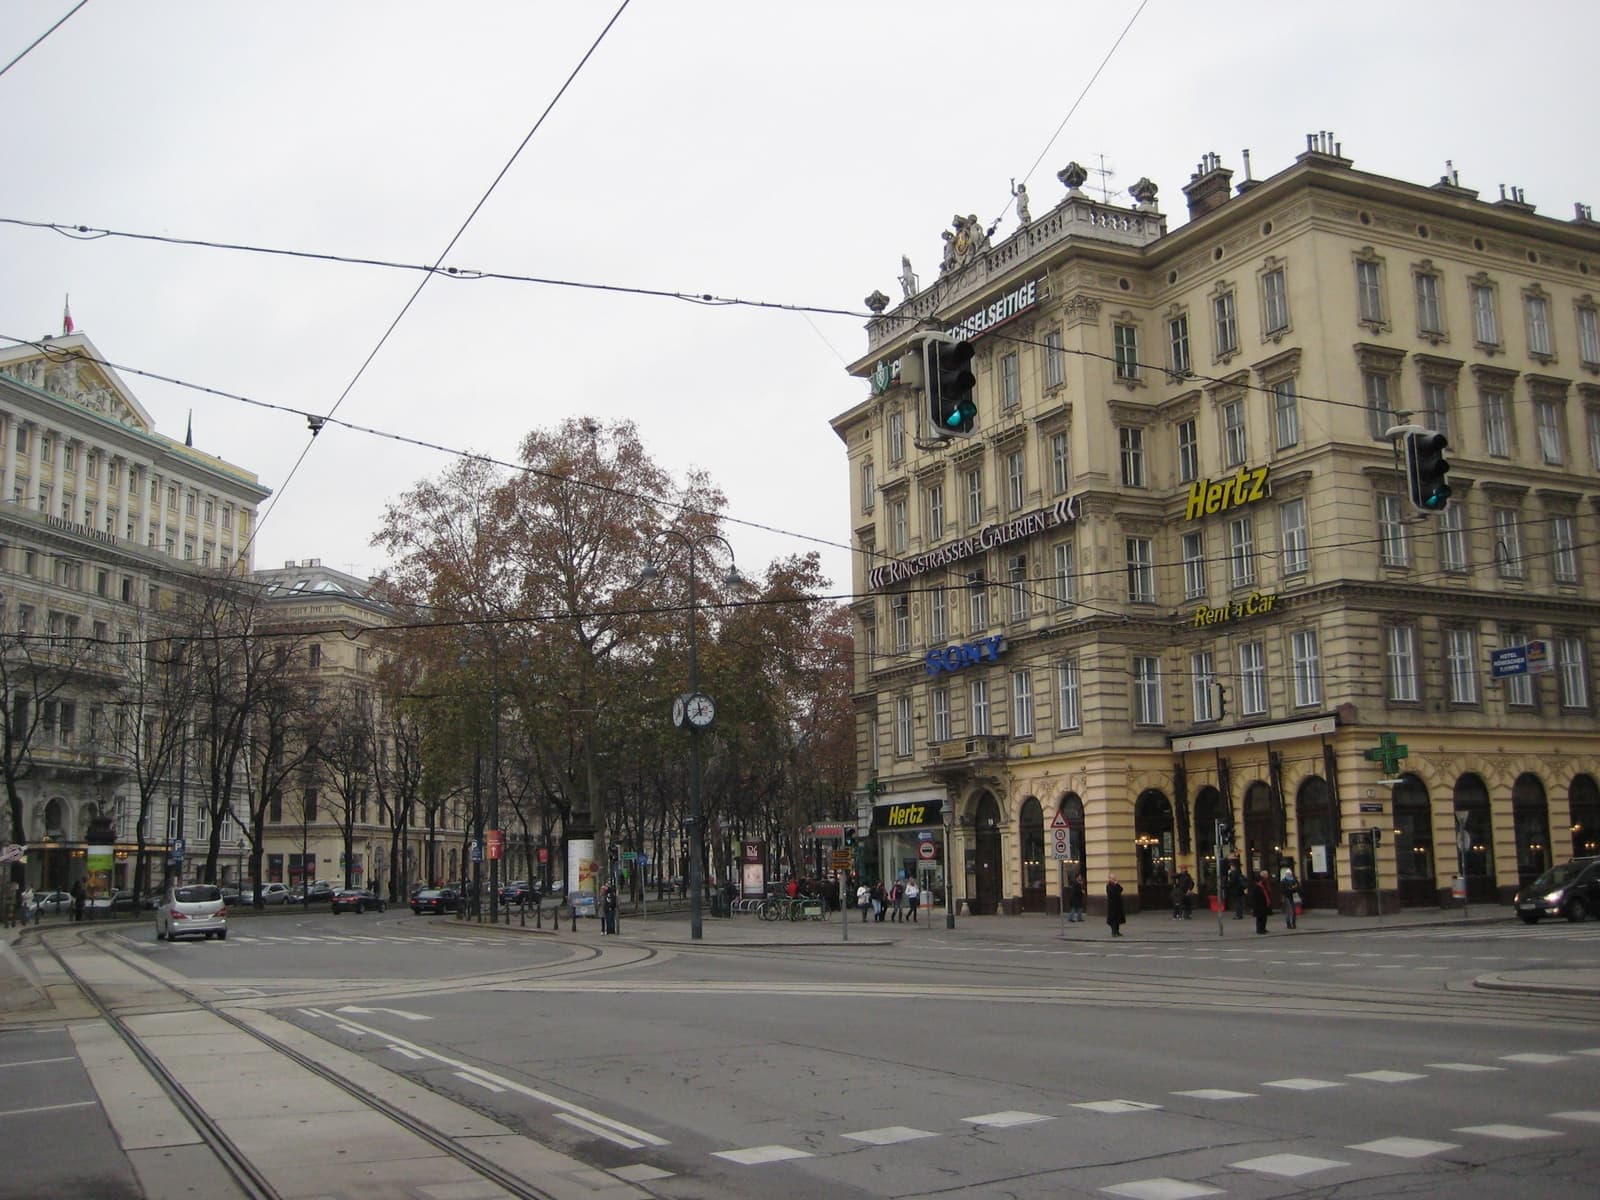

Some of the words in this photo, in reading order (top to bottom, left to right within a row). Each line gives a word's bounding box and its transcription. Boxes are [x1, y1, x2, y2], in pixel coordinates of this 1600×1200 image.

[1185, 466, 1269, 521] Hertz
[1193, 601, 1231, 628] Rent
[1236, 602, 1244, 617] a
[1246, 592, 1278, 615] Car
[925, 634, 1004, 676] SONY
[888, 804, 925, 826] Hertz
